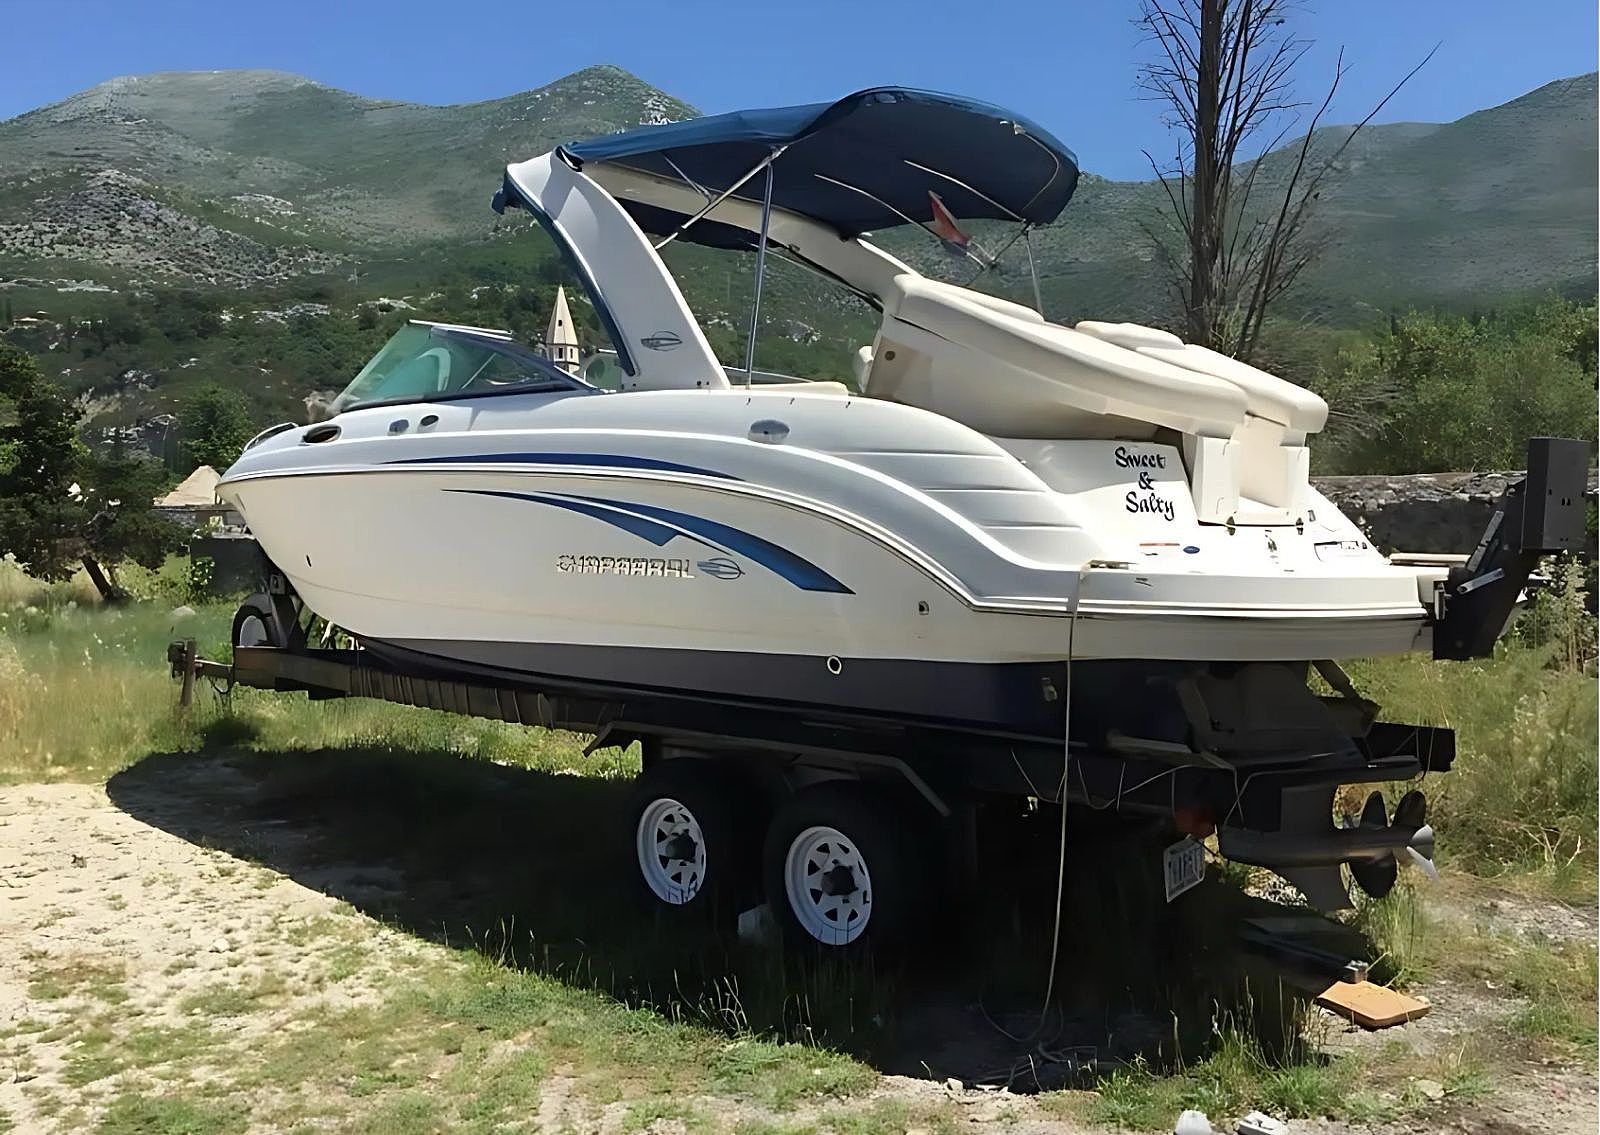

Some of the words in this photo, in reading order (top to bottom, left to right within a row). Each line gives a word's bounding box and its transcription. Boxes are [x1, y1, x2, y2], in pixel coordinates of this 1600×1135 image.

[1115, 446, 1166, 469] Sweet
[1139, 472, 1156, 490] &
[1126, 491, 1174, 521] Salty
[556, 555, 695, 578] CHAPARRAL
